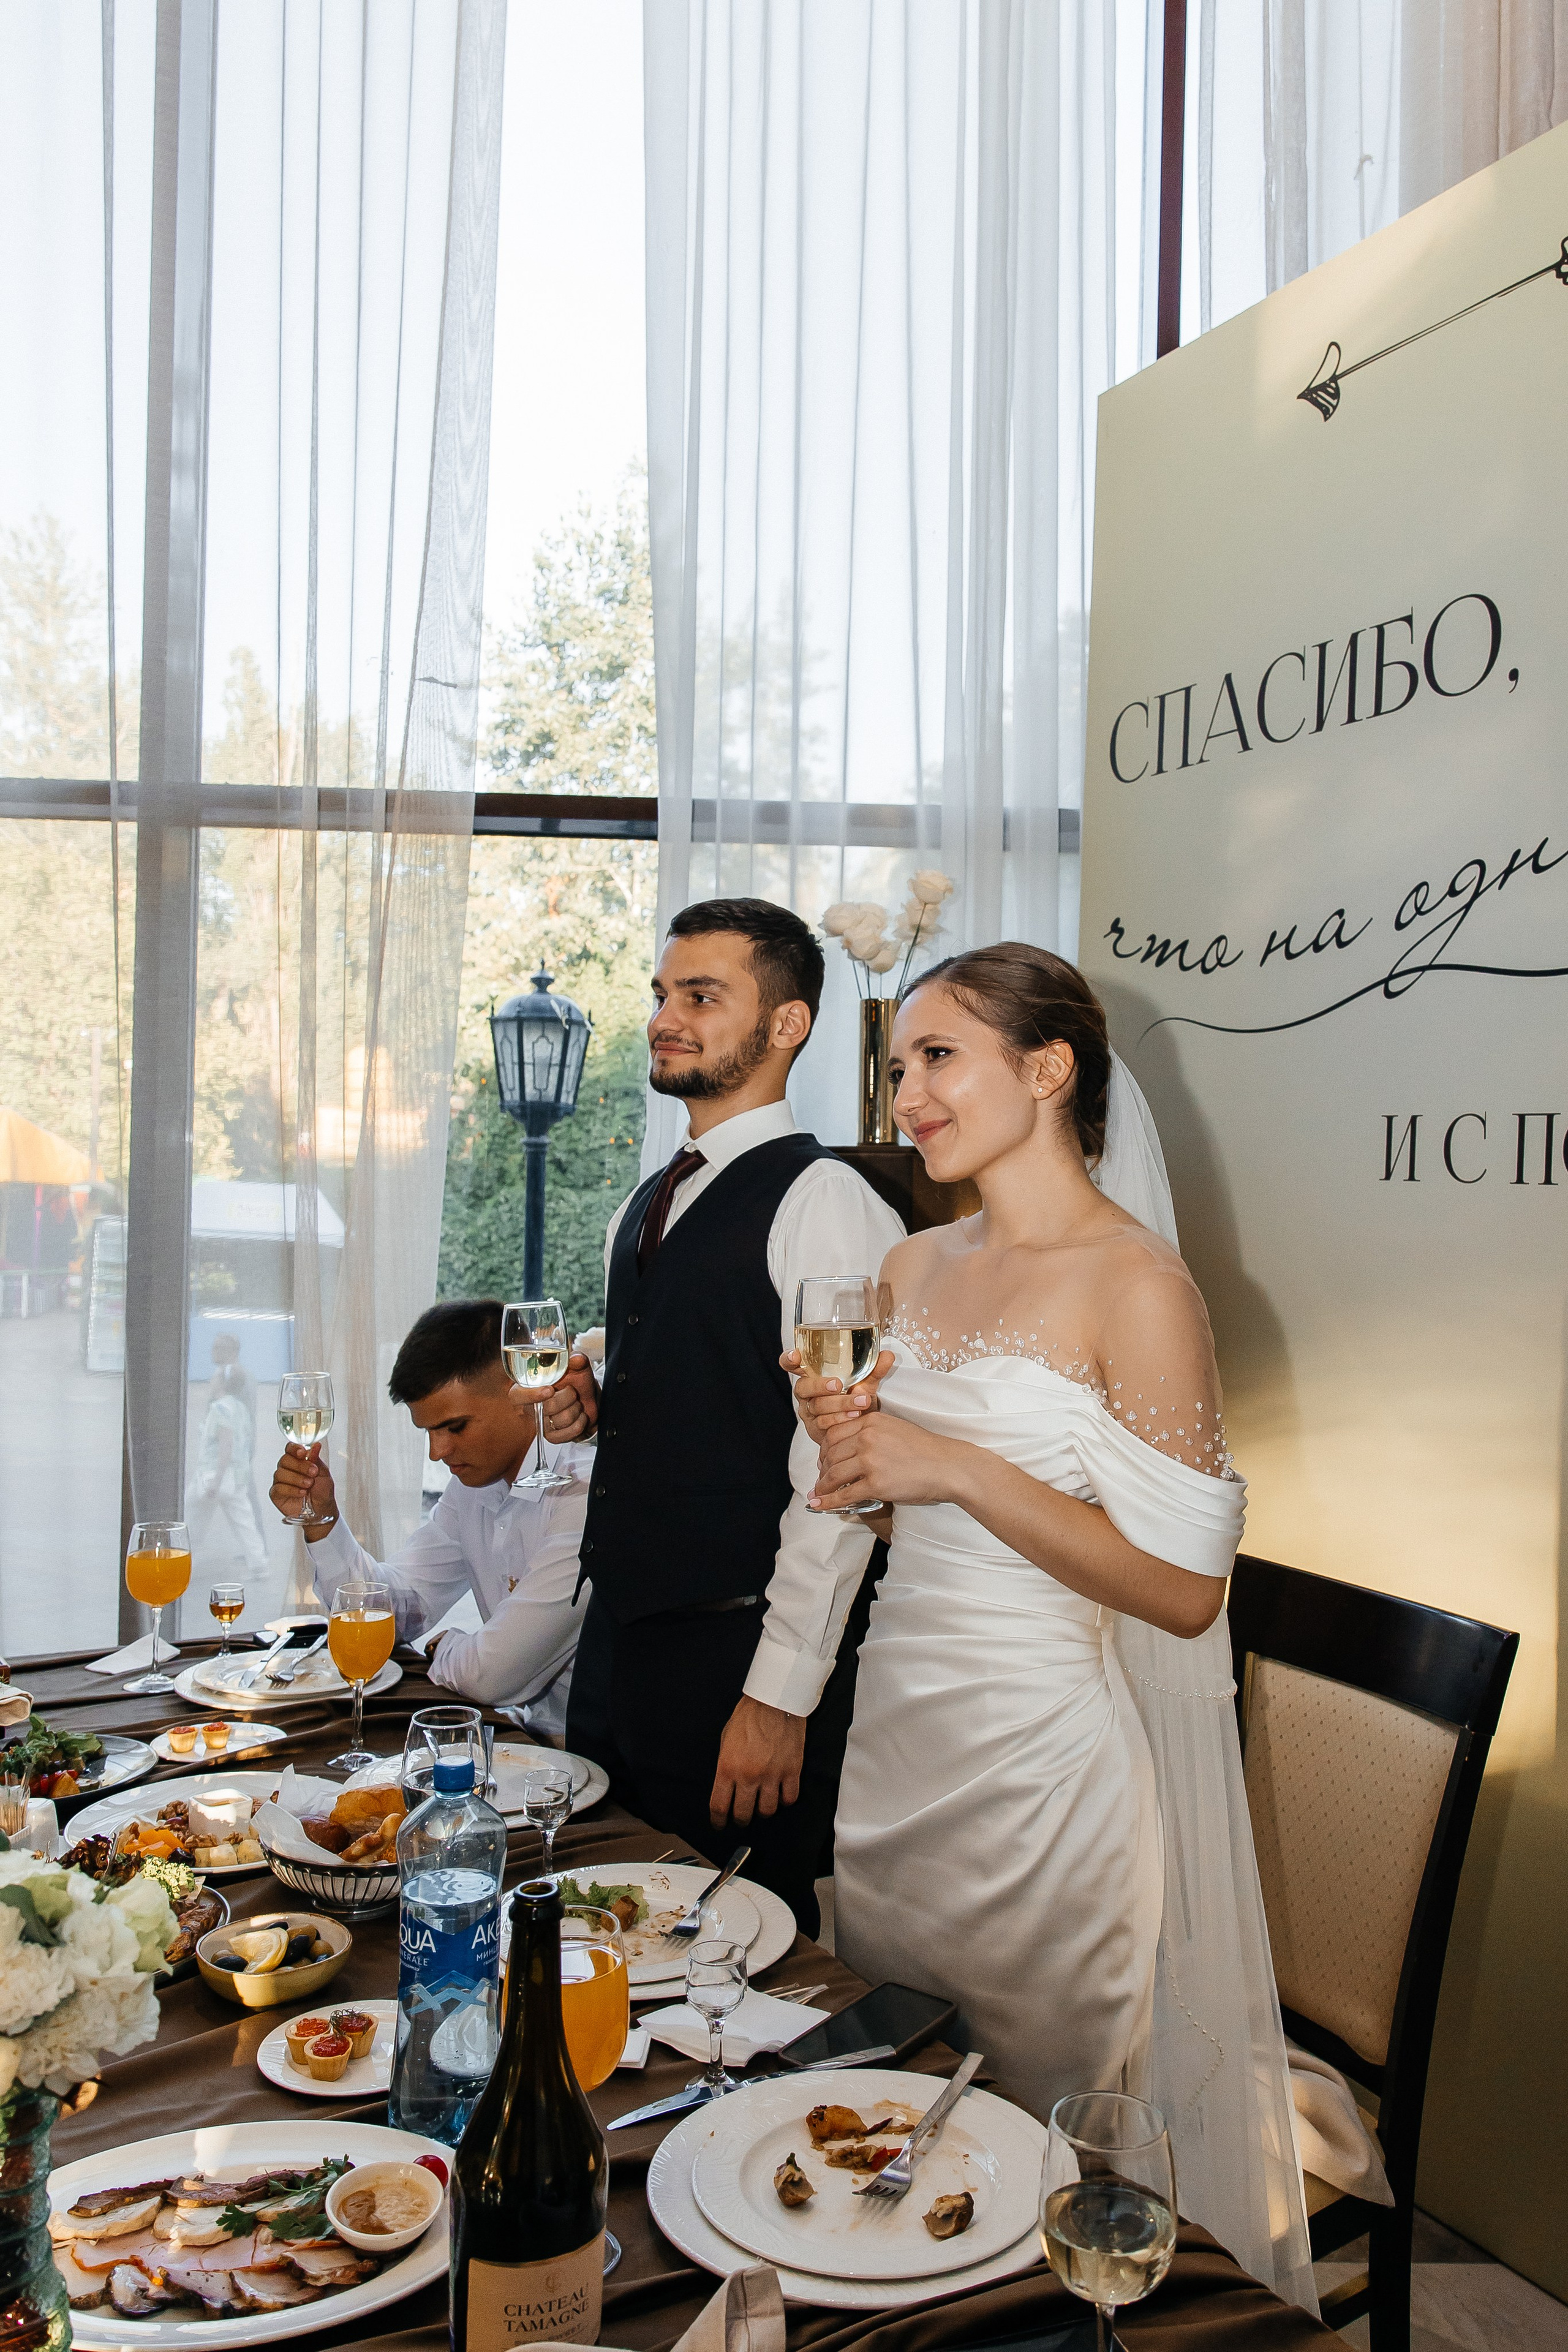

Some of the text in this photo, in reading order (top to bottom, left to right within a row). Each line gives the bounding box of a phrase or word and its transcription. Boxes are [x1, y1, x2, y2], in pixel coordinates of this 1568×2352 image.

[1109, 593, 1520, 783] СПАСИБО,
[1103, 917, 1244, 976] что
[1259, 908, 1373, 968] на
[1509, 1112, 1568, 1186] П
[502, 2299, 589, 2333] TAMAGNE
[503, 2282, 589, 2317] CHATEAU
